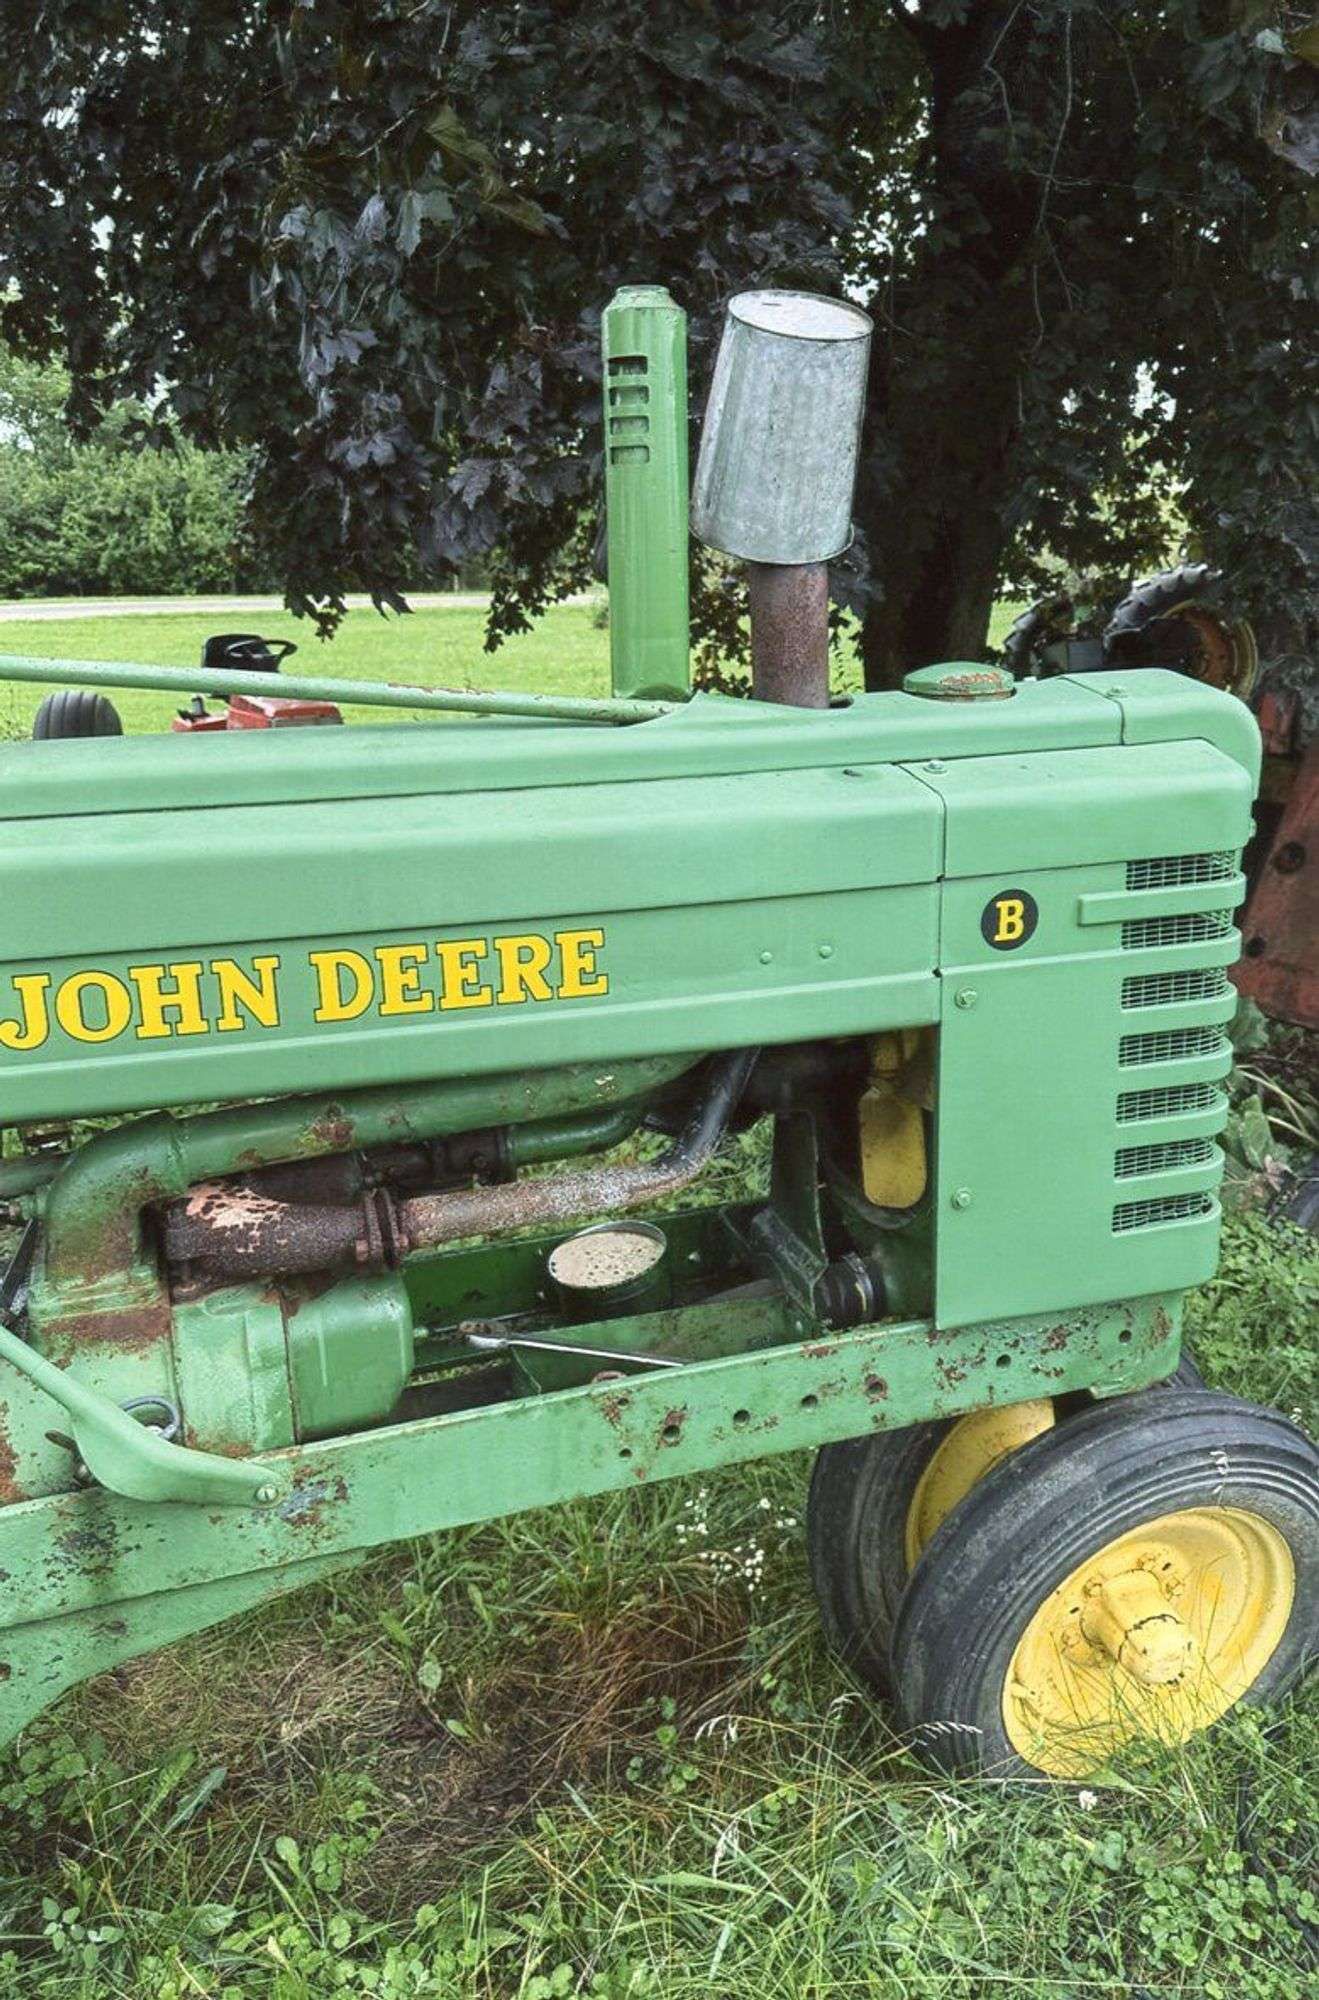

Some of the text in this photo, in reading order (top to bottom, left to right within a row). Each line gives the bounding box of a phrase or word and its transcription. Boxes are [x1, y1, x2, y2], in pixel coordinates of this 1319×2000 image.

[993, 899, 1025, 942] B
[0, 928, 608, 1051] JOHN DEERE
